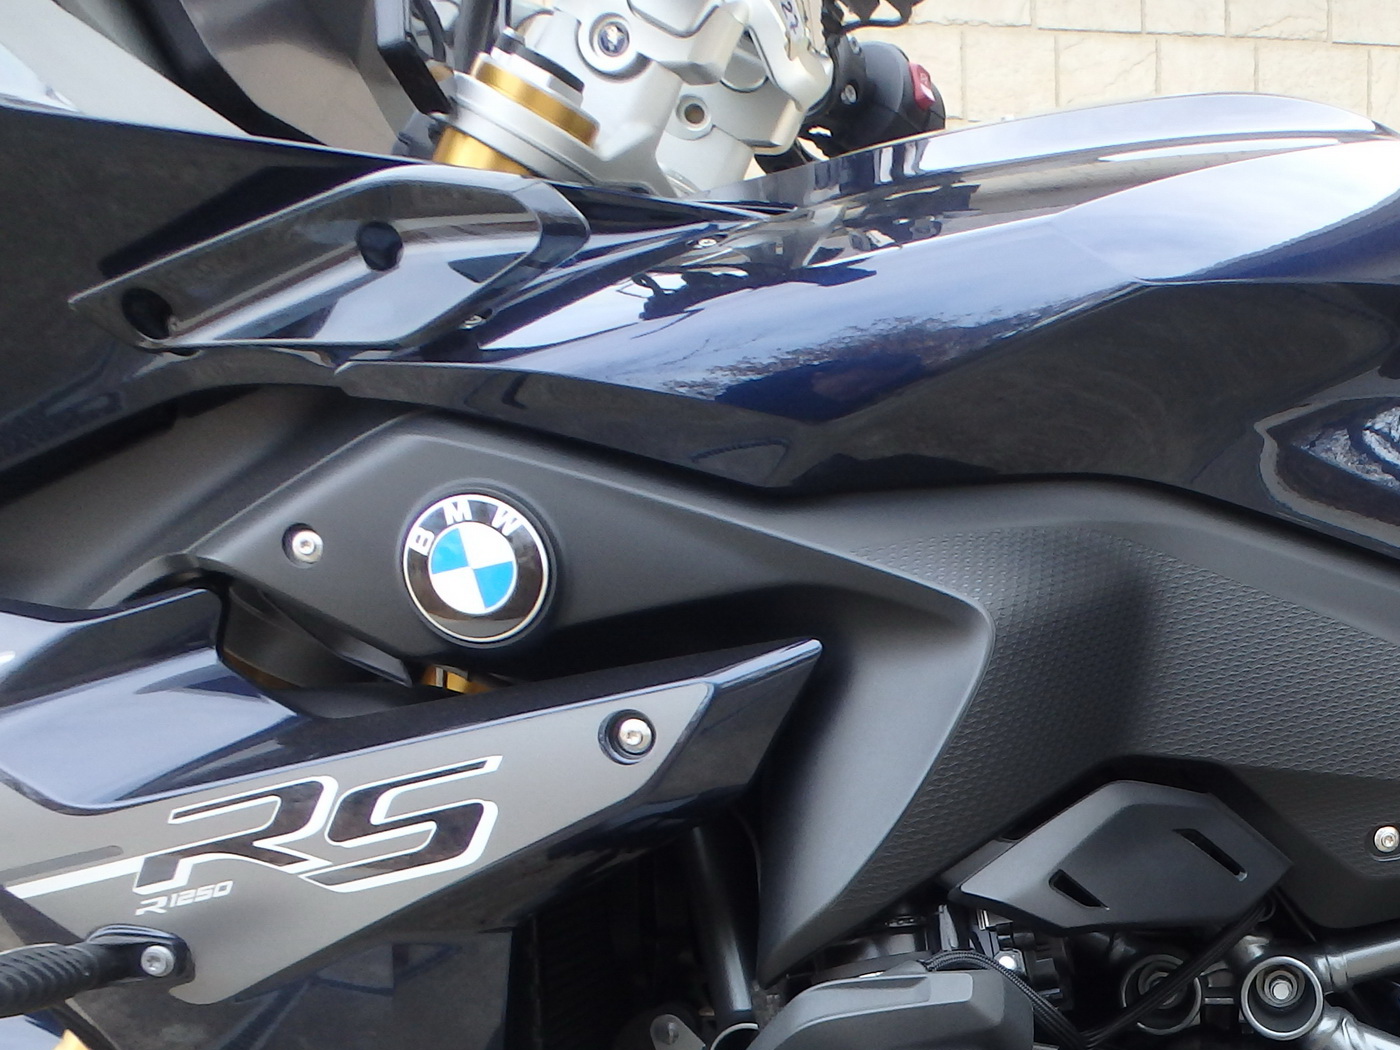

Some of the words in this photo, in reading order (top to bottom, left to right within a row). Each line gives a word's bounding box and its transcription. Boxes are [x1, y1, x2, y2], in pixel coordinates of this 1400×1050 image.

[408, 500, 523, 556] BMW
[131, 755, 503, 893] RS
[135, 880, 234, 916] R1250
